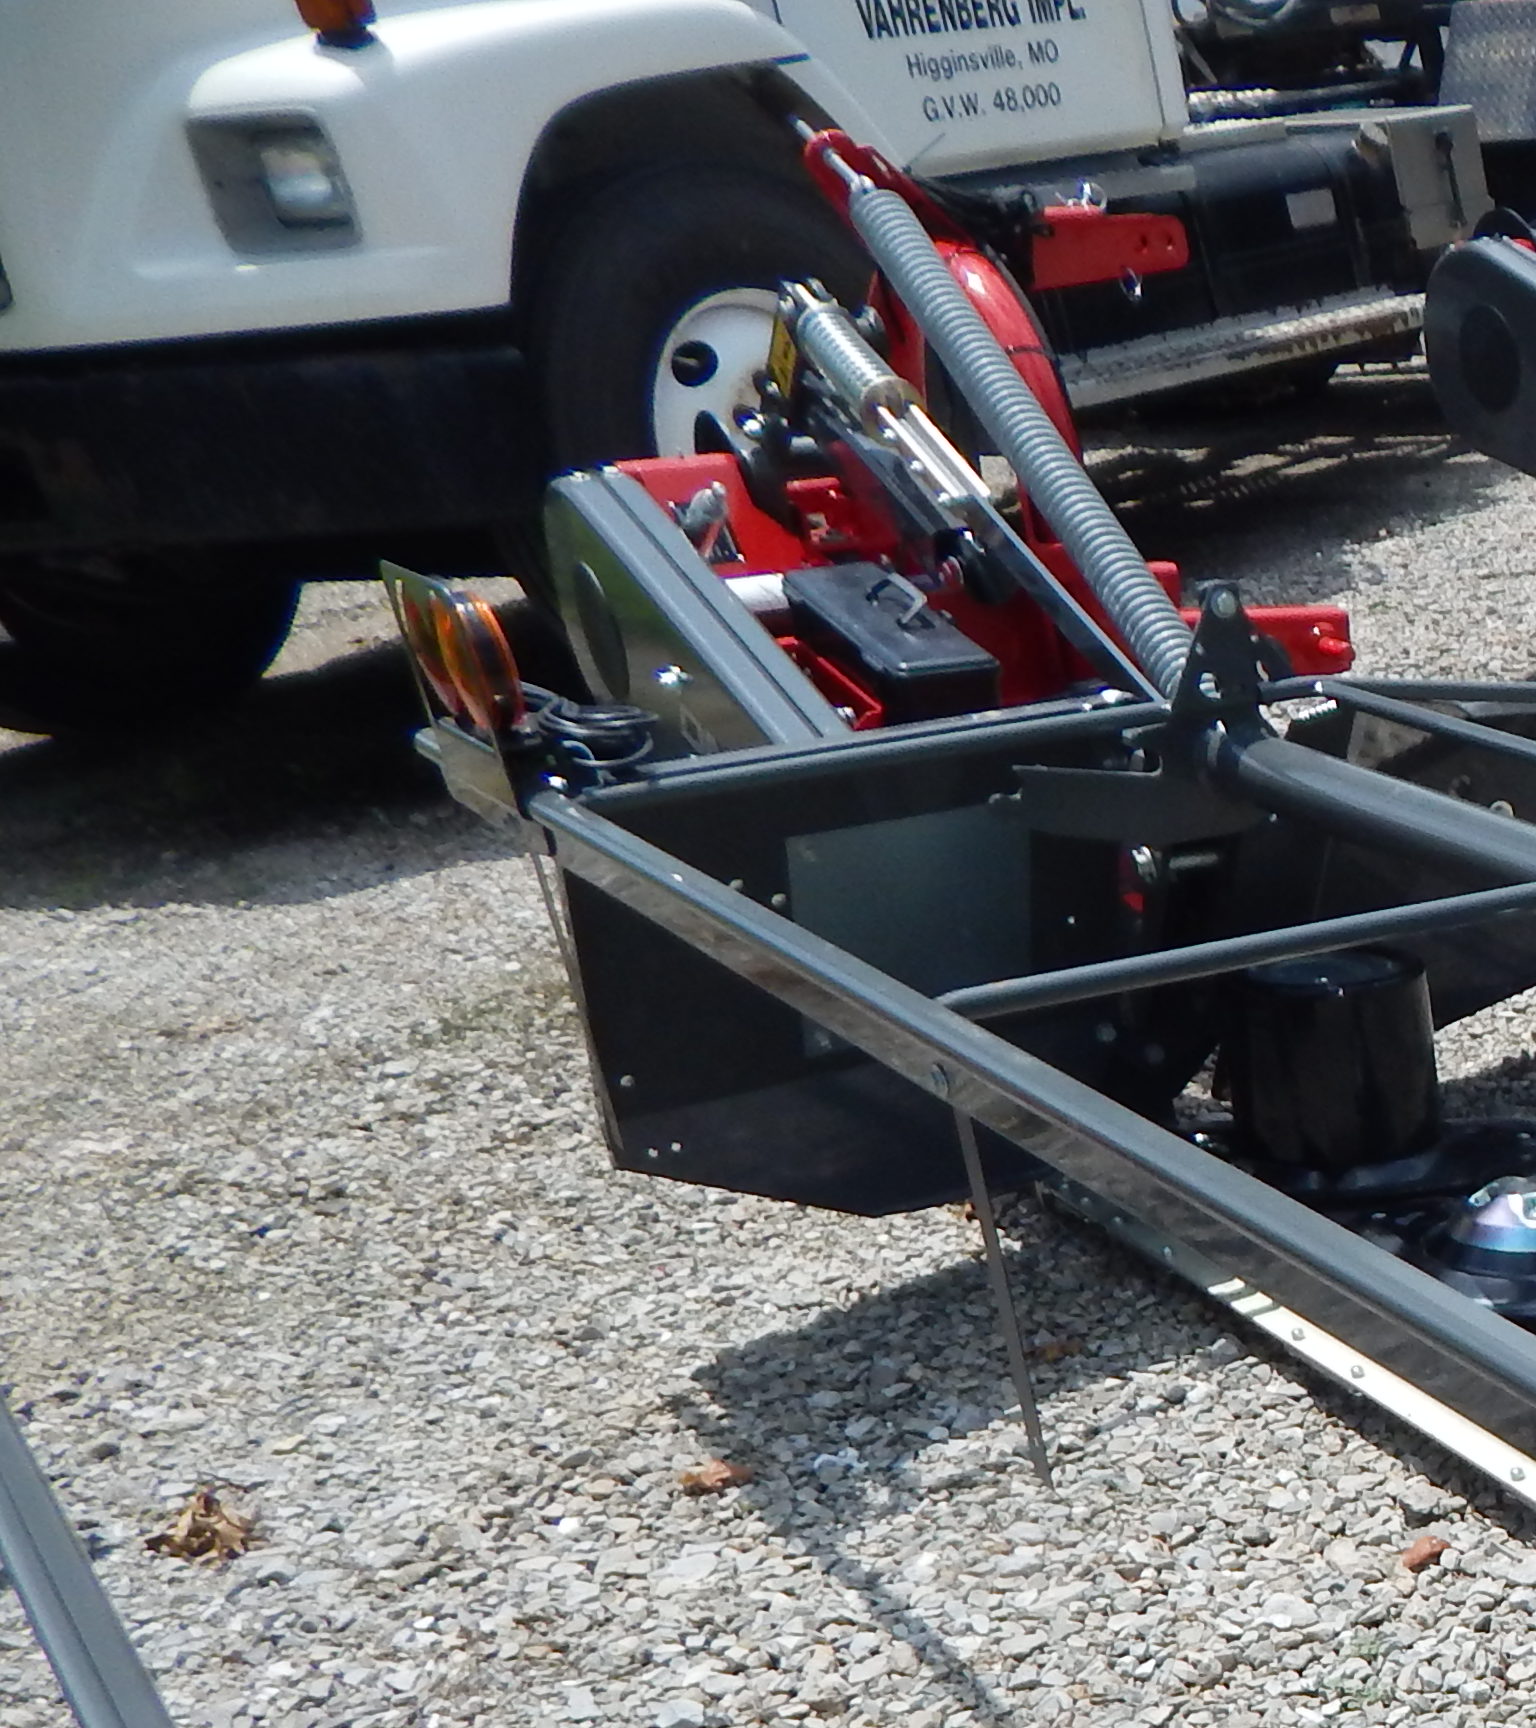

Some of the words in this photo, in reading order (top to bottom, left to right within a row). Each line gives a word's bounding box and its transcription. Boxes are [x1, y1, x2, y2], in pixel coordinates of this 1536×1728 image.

[906, 45, 1024, 82] Higginsville,
[1027, 39, 1060, 64] MO
[922, 93, 987, 122] G.V.W.
[993, 82, 1062, 113] 48,000
